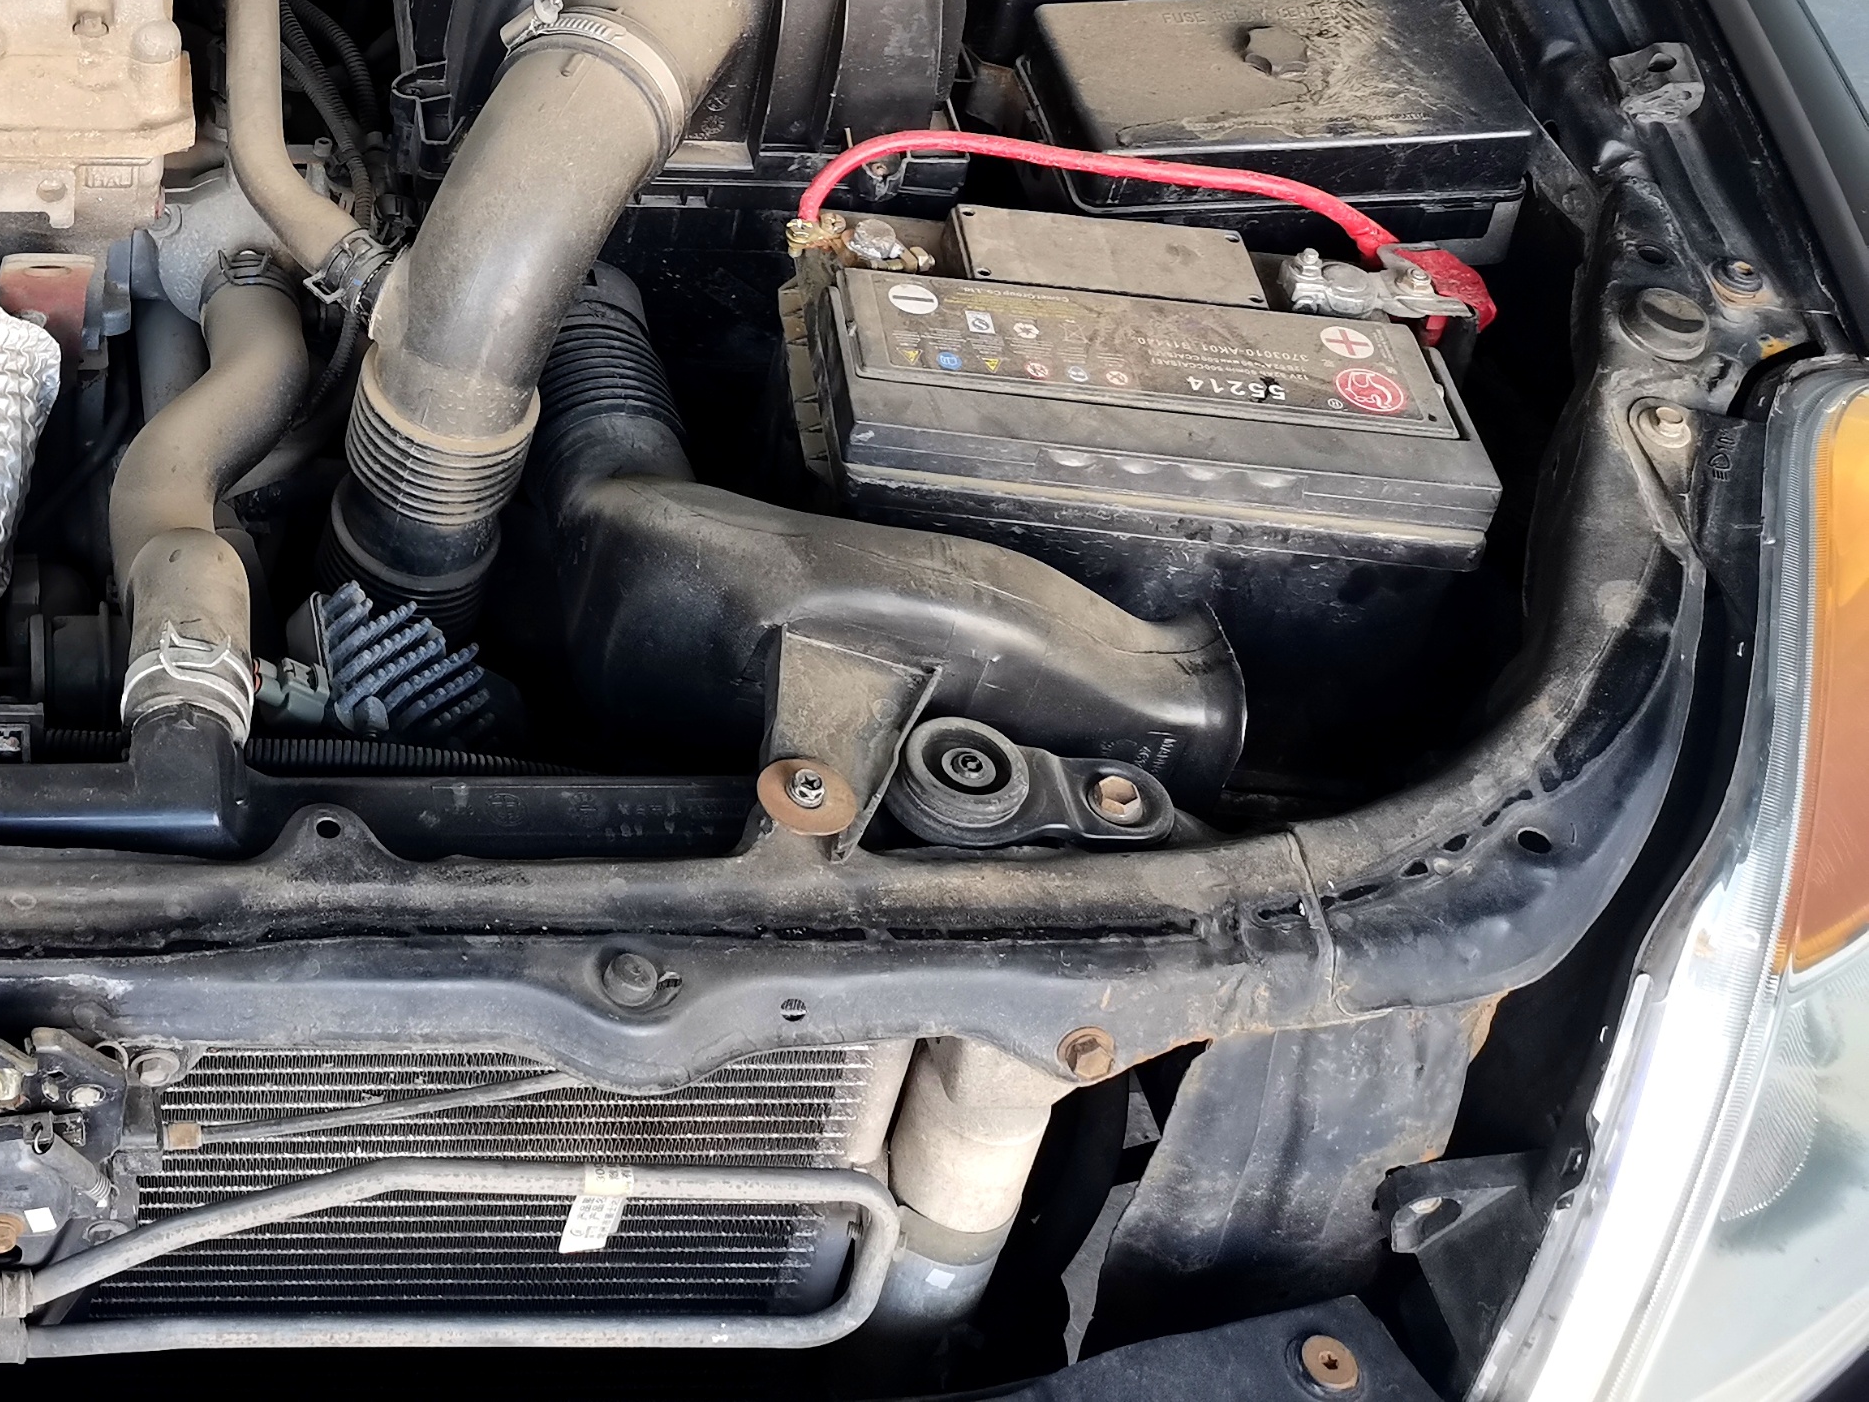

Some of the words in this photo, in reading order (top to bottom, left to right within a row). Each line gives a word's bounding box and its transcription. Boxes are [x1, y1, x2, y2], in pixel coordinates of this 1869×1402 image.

[1162, 11, 1205, 24] FUSE
[1214, 9, 1267, 23] RELAY
[1186, 376, 1286, 400] 55214
